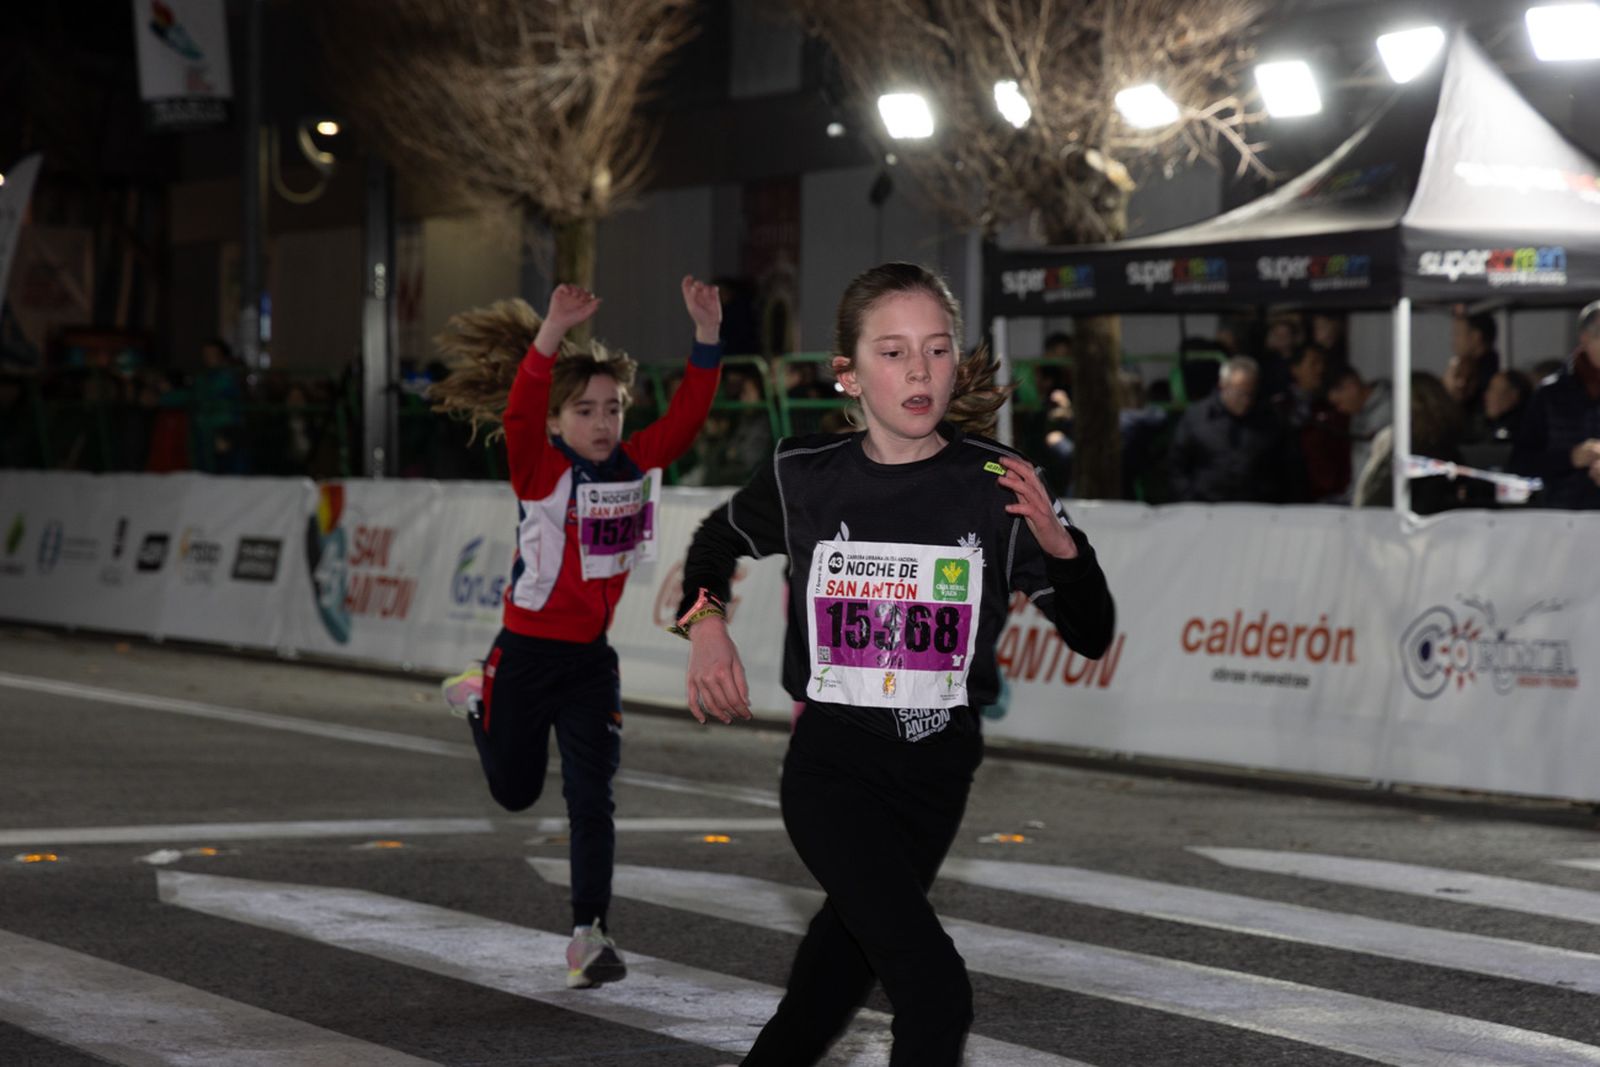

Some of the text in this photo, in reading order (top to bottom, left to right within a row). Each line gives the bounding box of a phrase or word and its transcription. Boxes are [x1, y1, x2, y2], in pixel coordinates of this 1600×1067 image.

[350, 525, 393, 568] SAN
[829, 557, 842, 568] 43
[845, 561, 919, 578] NOCHE DE
[826, 579, 917, 600] SAN ANTÓN
[826, 601, 960, 653] 15368
[1180, 608, 1356, 664] calderón
[898, 708, 932, 722] SAN
